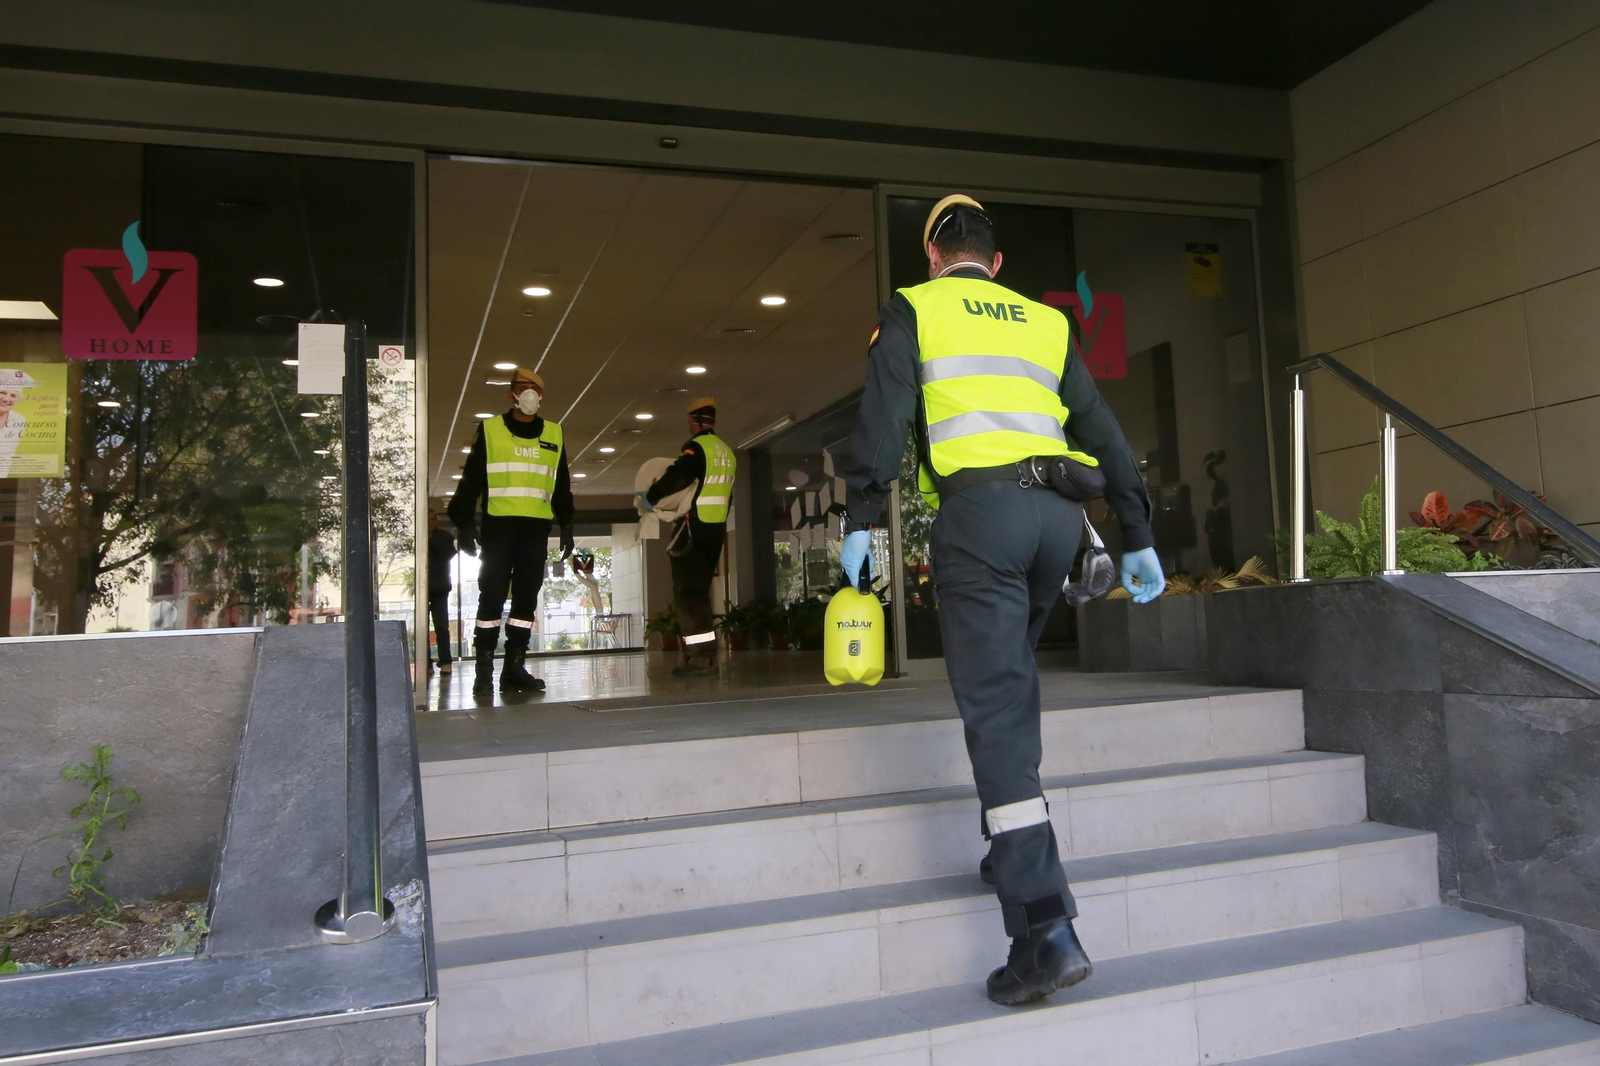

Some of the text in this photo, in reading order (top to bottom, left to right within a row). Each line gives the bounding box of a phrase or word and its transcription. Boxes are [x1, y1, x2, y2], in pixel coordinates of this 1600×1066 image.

[80, 265, 184, 335] V
[962, 298, 1028, 324] UME
[89, 338, 173, 355] HOME
[5, 418, 58, 428] Concurso
[18, 429, 57, 439] Cocina
[514, 446, 541, 459] UME
[837, 619, 872, 628] natuur
[851, 644, 858, 653] 2
